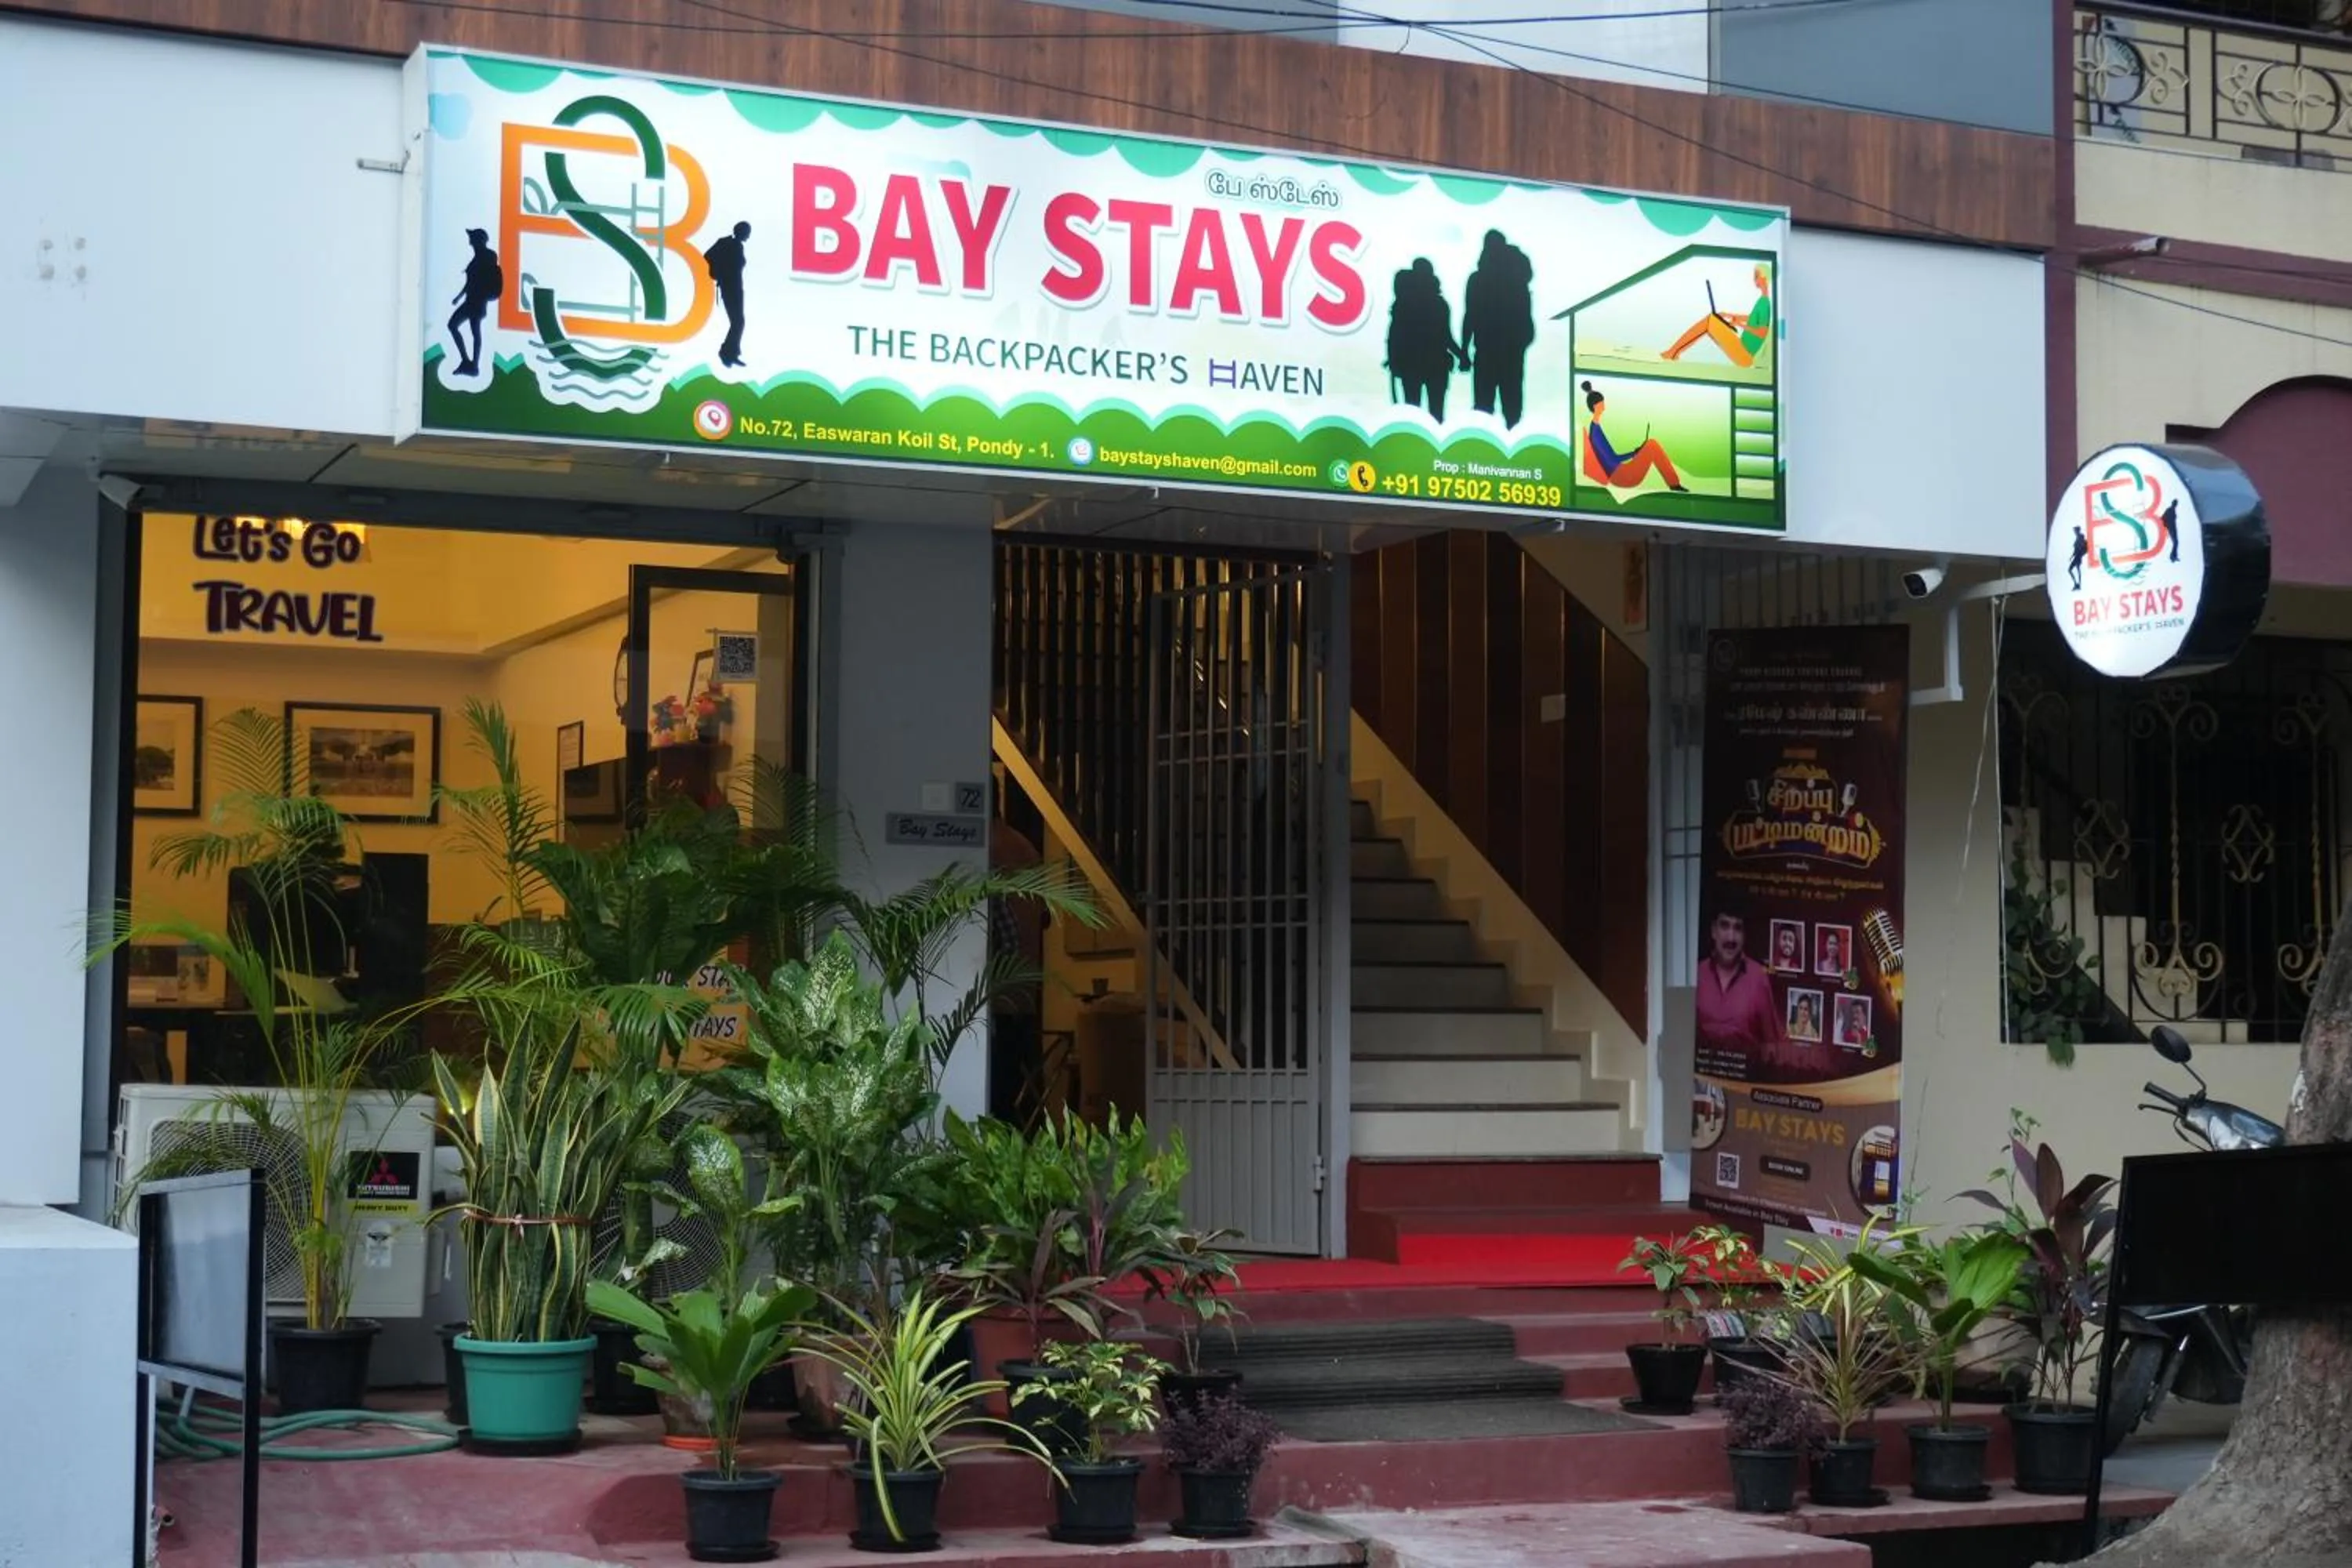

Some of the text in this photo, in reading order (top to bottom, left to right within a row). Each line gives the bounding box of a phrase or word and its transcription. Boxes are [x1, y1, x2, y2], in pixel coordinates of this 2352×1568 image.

[1207, 171, 1242, 197] பே
[792, 162, 1366, 327] BAY STAYS
[847, 325, 1323, 396] THE BACKPACKER'S HAVEN
[739, 416, 797, 440] No.72,
[804, 423, 891, 445] Easwaran
[897, 430, 933, 449] Koil
[938, 434, 963, 453] St,
[967, 436, 1022, 459] Pondy
[1099, 446, 1317, 478] baystayshaven@gmail.com
[1433, 459, 1459, 475] Prop
[1468, 463, 1531, 479] Manivannan
[1534, 468, 1542, 480] S
[1381, 474, 1561, 507] +91 97502 56939
[194, 515, 361, 568] Let's Go
[192, 581, 383, 642] TRAVEL
[2073, 584, 2184, 627] BAY STAYS
[960, 788, 981, 808] 72
[898, 818, 927, 838] Bay
[1735, 1108, 1845, 1147] BAY STAYS
